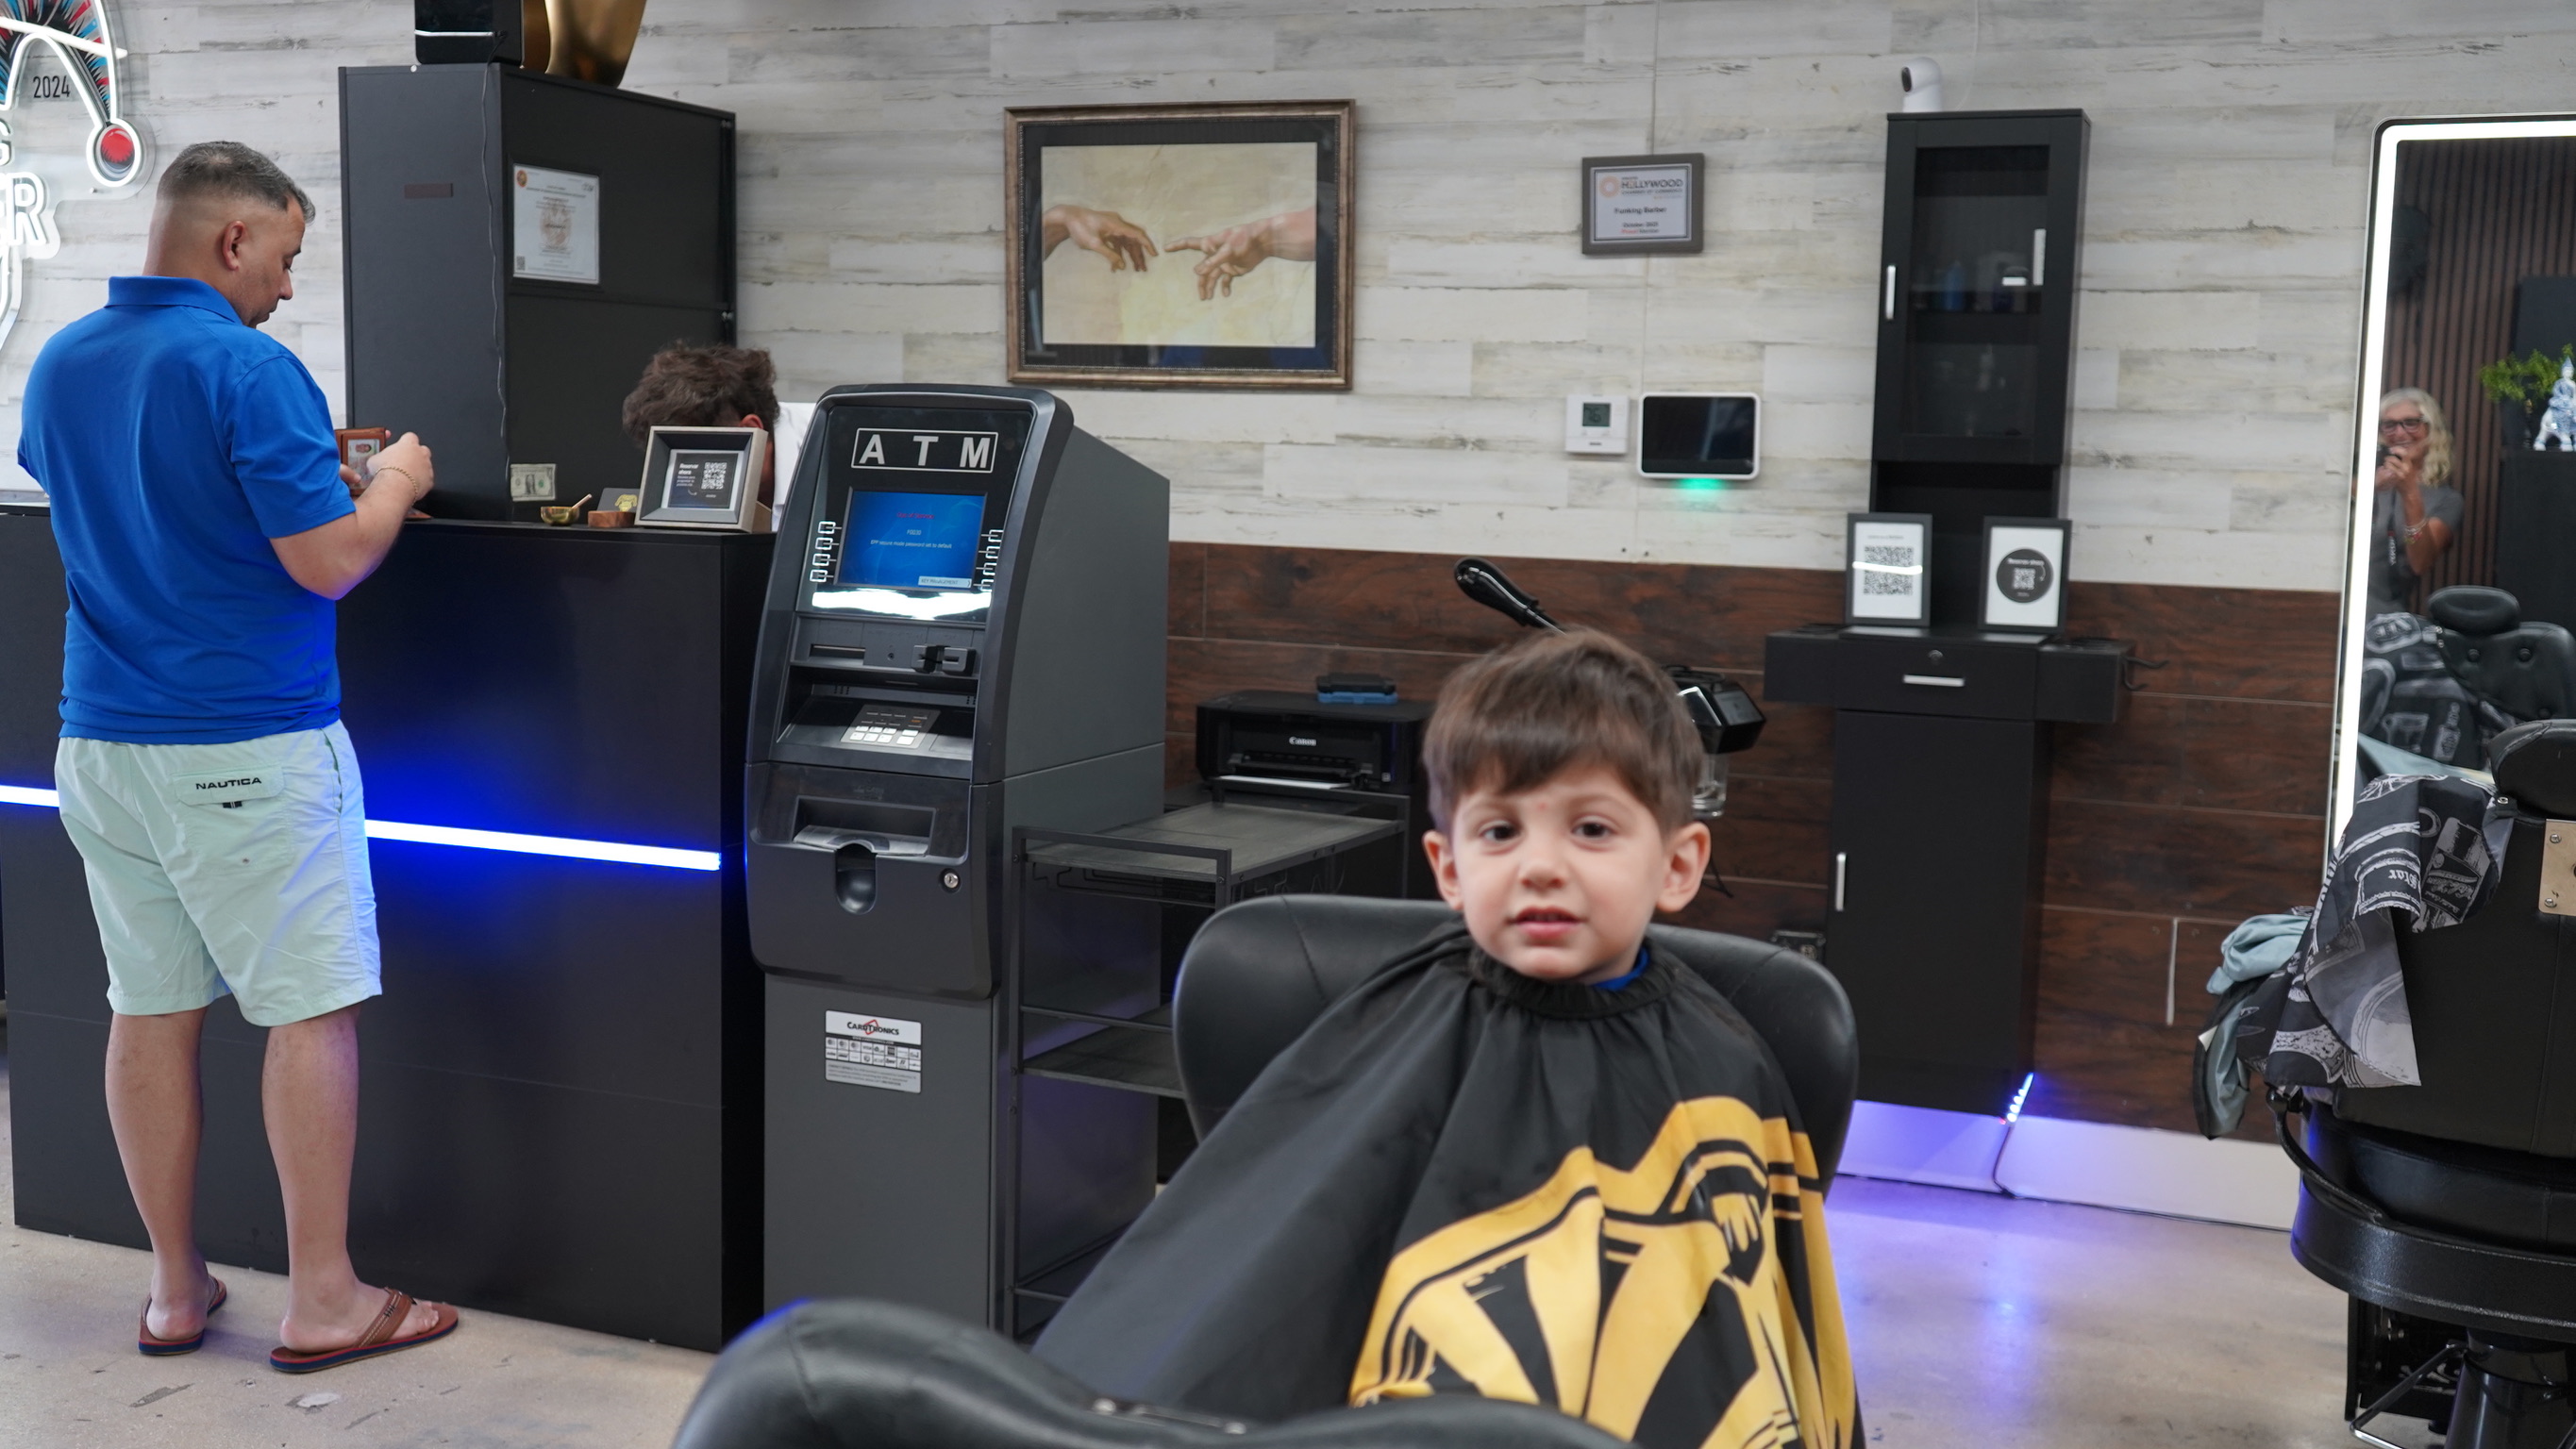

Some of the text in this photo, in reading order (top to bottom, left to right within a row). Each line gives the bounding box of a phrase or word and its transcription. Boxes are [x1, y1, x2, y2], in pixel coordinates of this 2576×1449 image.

[32, 75, 71, 98] 2024
[1621, 179, 1683, 189] HOLLYWOOD
[1289, 736, 1316, 746] Canon
[195, 777, 262, 790] NAUTICA
